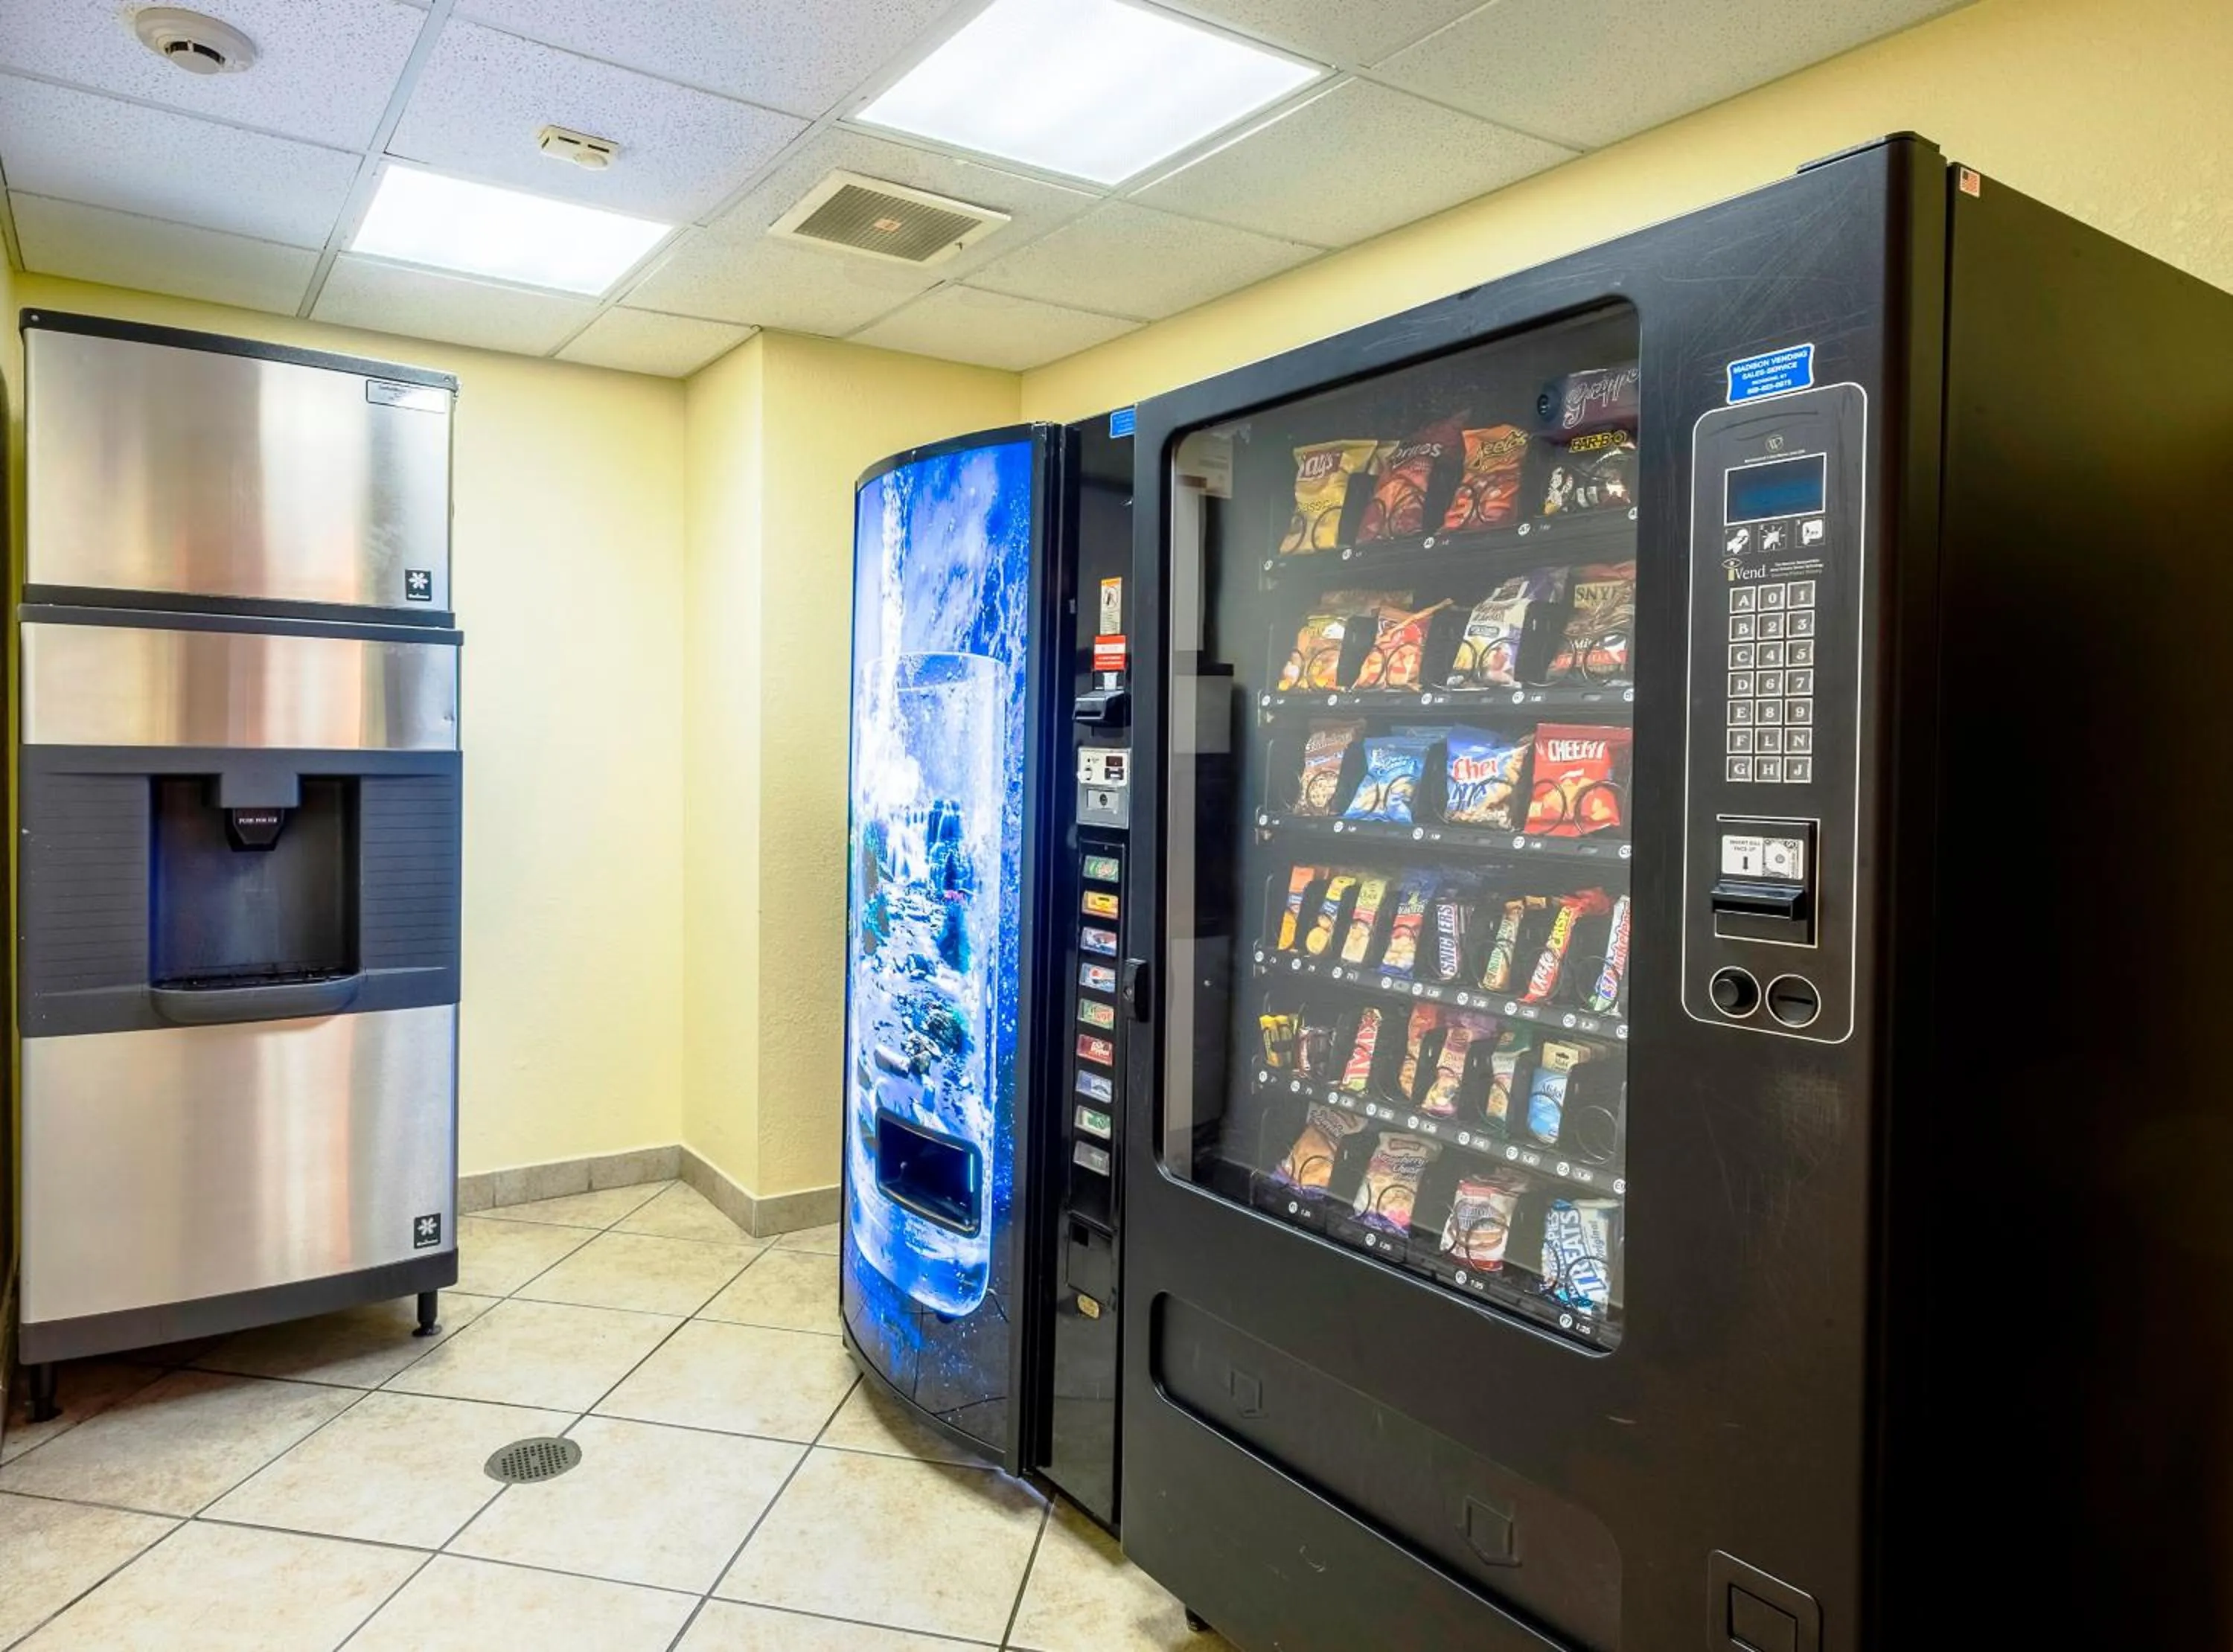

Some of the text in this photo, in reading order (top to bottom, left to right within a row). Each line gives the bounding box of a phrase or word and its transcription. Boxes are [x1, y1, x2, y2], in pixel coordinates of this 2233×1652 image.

[1733, 350, 1808, 374] MADISON VENDING
[1739, 590, 1805, 606] A 0 1
[1738, 619, 1806, 634] B 2 3
[1737, 649, 1806, 662] C 4 5
[1737, 677, 1805, 690] D 6 7
[1737, 707, 1804, 718] E 8 9
[1737, 734, 1805, 746] F L N
[1734, 763, 1803, 775] G H J
[1436, 904, 1458, 977] SNICERS
[1591, 1220, 1607, 1260] Original
[1560, 1210, 1608, 1298] TREATS
